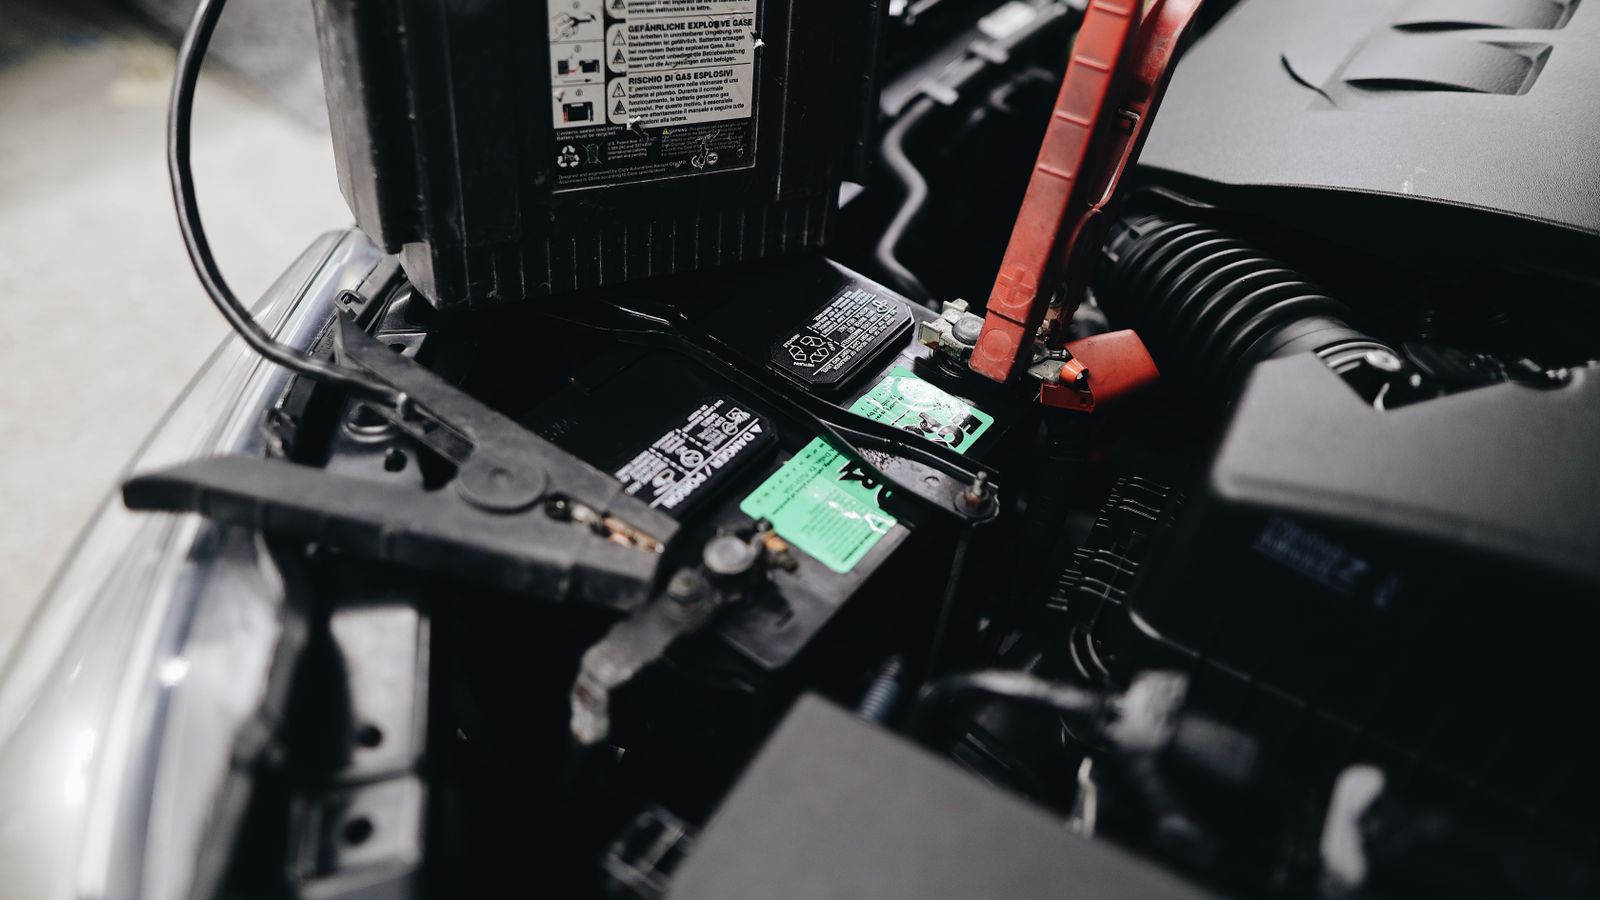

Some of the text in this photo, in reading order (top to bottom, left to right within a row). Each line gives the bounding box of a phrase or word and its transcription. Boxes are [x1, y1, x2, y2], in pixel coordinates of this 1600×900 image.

[629, 75, 661, 84] RISCHIO
[675, 72, 691, 80] GAS
[693, 69, 732, 79] ESPLOSIVI
[709, 432, 754, 468] DANGER
